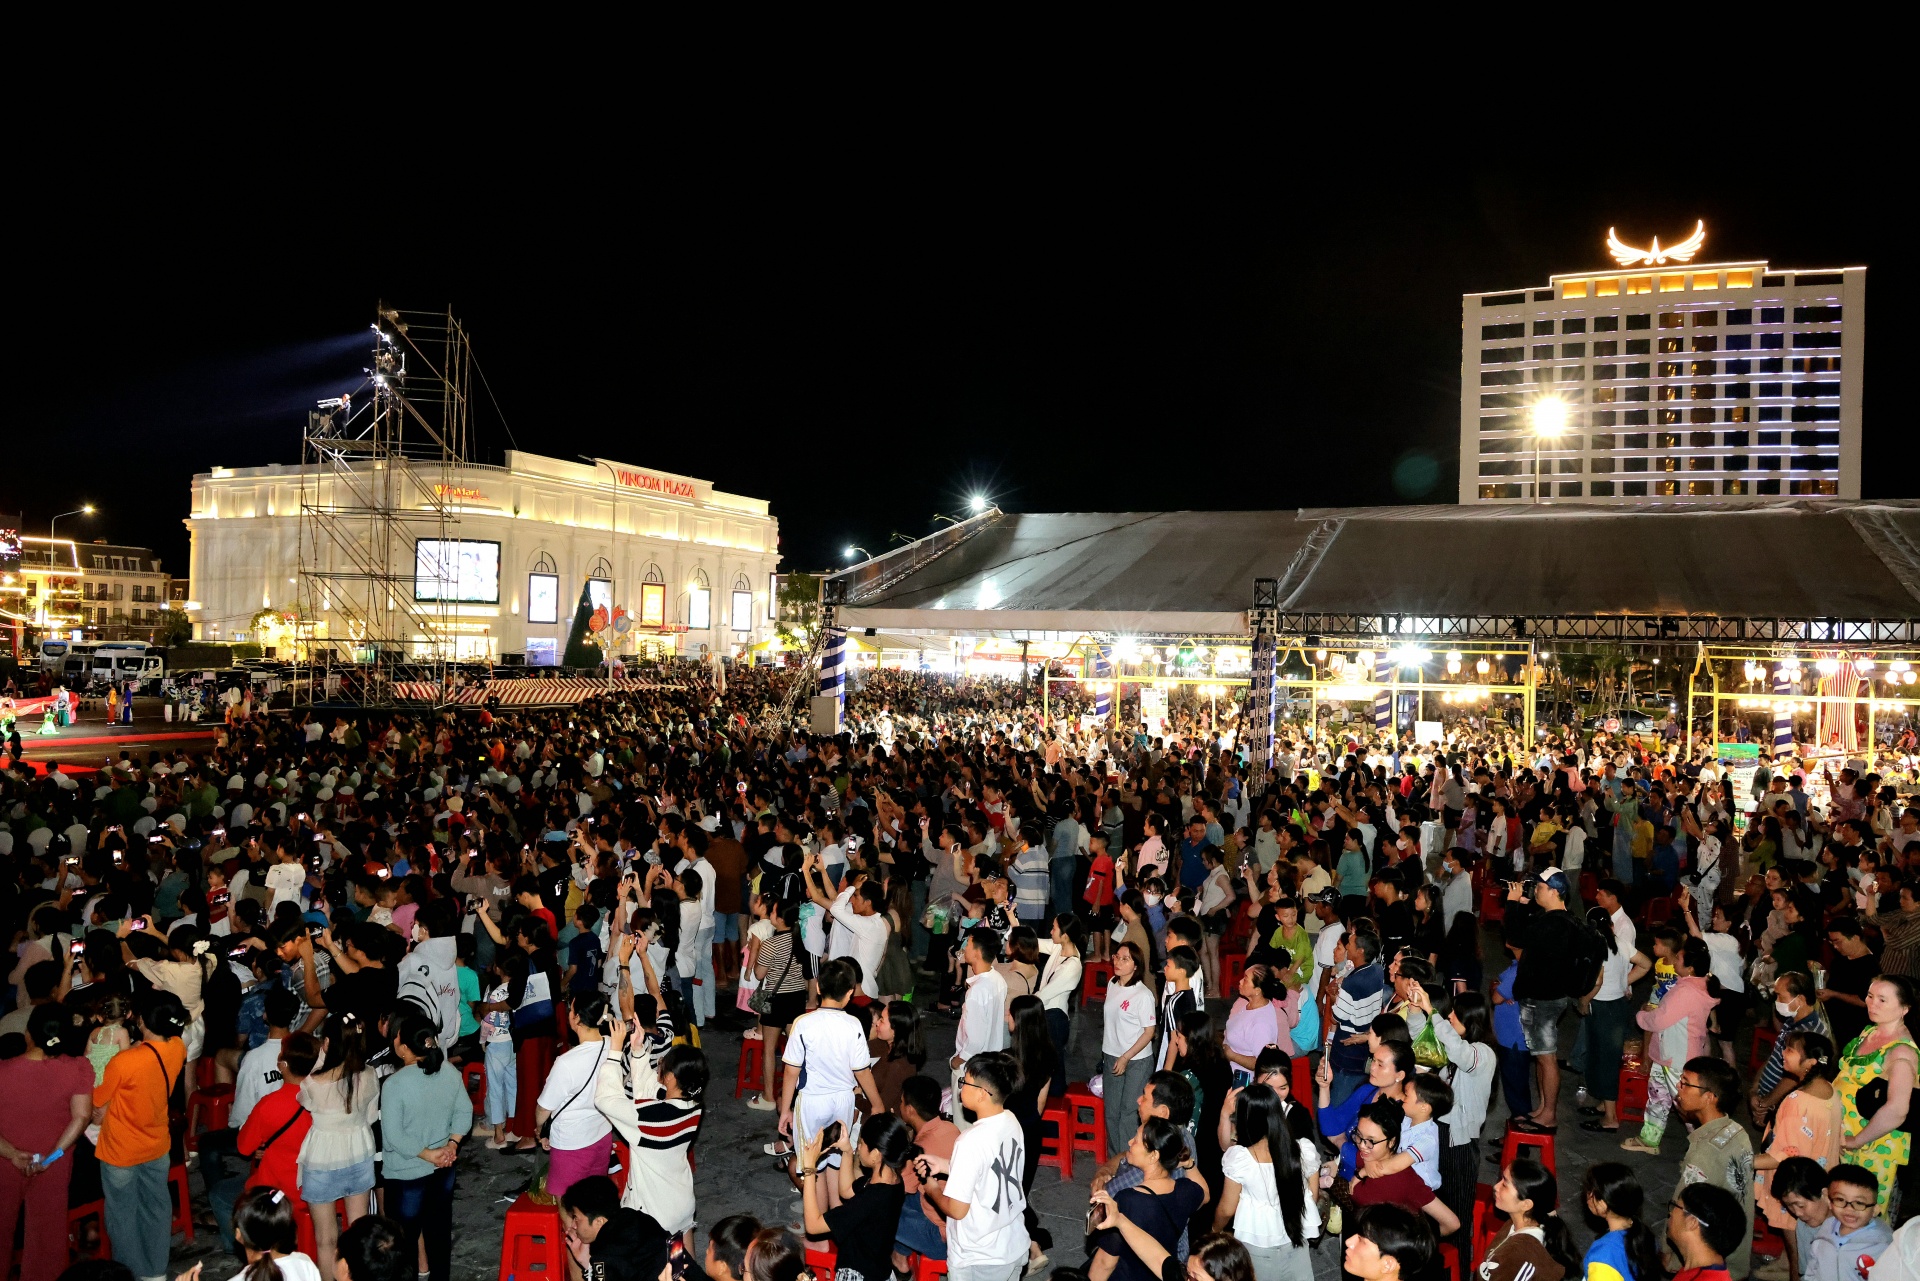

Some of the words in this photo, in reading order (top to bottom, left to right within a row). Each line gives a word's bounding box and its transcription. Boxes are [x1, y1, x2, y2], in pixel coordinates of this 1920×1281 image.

[617, 470, 662, 492] VINCOM
[663, 480, 696, 499] PLAZA
[990, 1137, 1024, 1215] NY
